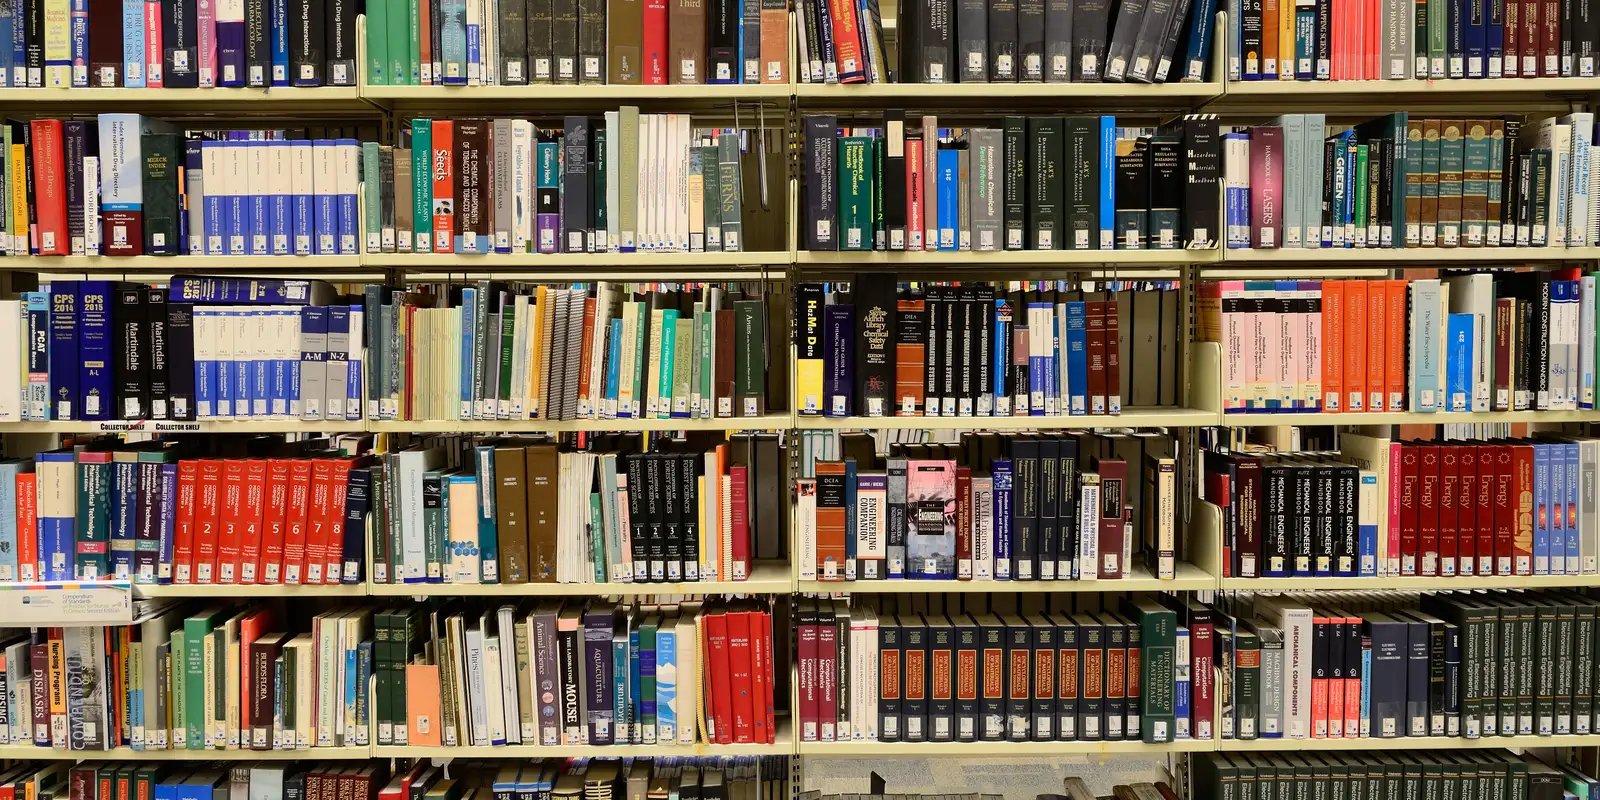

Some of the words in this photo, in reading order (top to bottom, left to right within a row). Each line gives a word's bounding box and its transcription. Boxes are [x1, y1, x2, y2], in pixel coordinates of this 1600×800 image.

[44, 125, 53, 164] Dictionary
[1188, 150, 1216, 158] Hazardous
[46, 166, 53, 174] of
[436, 150, 448, 181] Seeds
[1188, 162, 1216, 170] Materials
[1188, 175, 1216, 183] Handbook
[1335, 157, 1345, 198] GREEN
[722, 167, 734, 212] FERNS
[1263, 189, 1273, 224] LASERS
[53, 294, 75, 303] CPS
[84, 295, 103, 303] CPS
[184, 280, 193, 299] CPS
[807, 300, 817, 334] HazMat
[129, 322, 139, 371] Martindale
[155, 322, 164, 370] Martindale
[807, 336, 816, 356] Data
[156, 422, 184, 430] COLLECTOR
[1402, 476, 1417, 509] Energy
[1460, 476, 1474, 509] Energy
[1497, 475, 1511, 507] Energy
[981, 492, 990, 520] CIVIL
[204, 524, 211, 534] 2
[248, 524, 255, 534] 4
[293, 524, 300, 534] 6
[334, 524, 341, 534] 8
[980, 520, 989, 560] Engineer's
[537, 622, 545, 648] Animal
[52, 642, 60, 670] Nursing
[471, 648, 479, 671] Pines
[34, 669, 43, 718] DISEASES
[566, 684, 577, 723] MOUSE
[1164, 700, 1170, 711] OF
